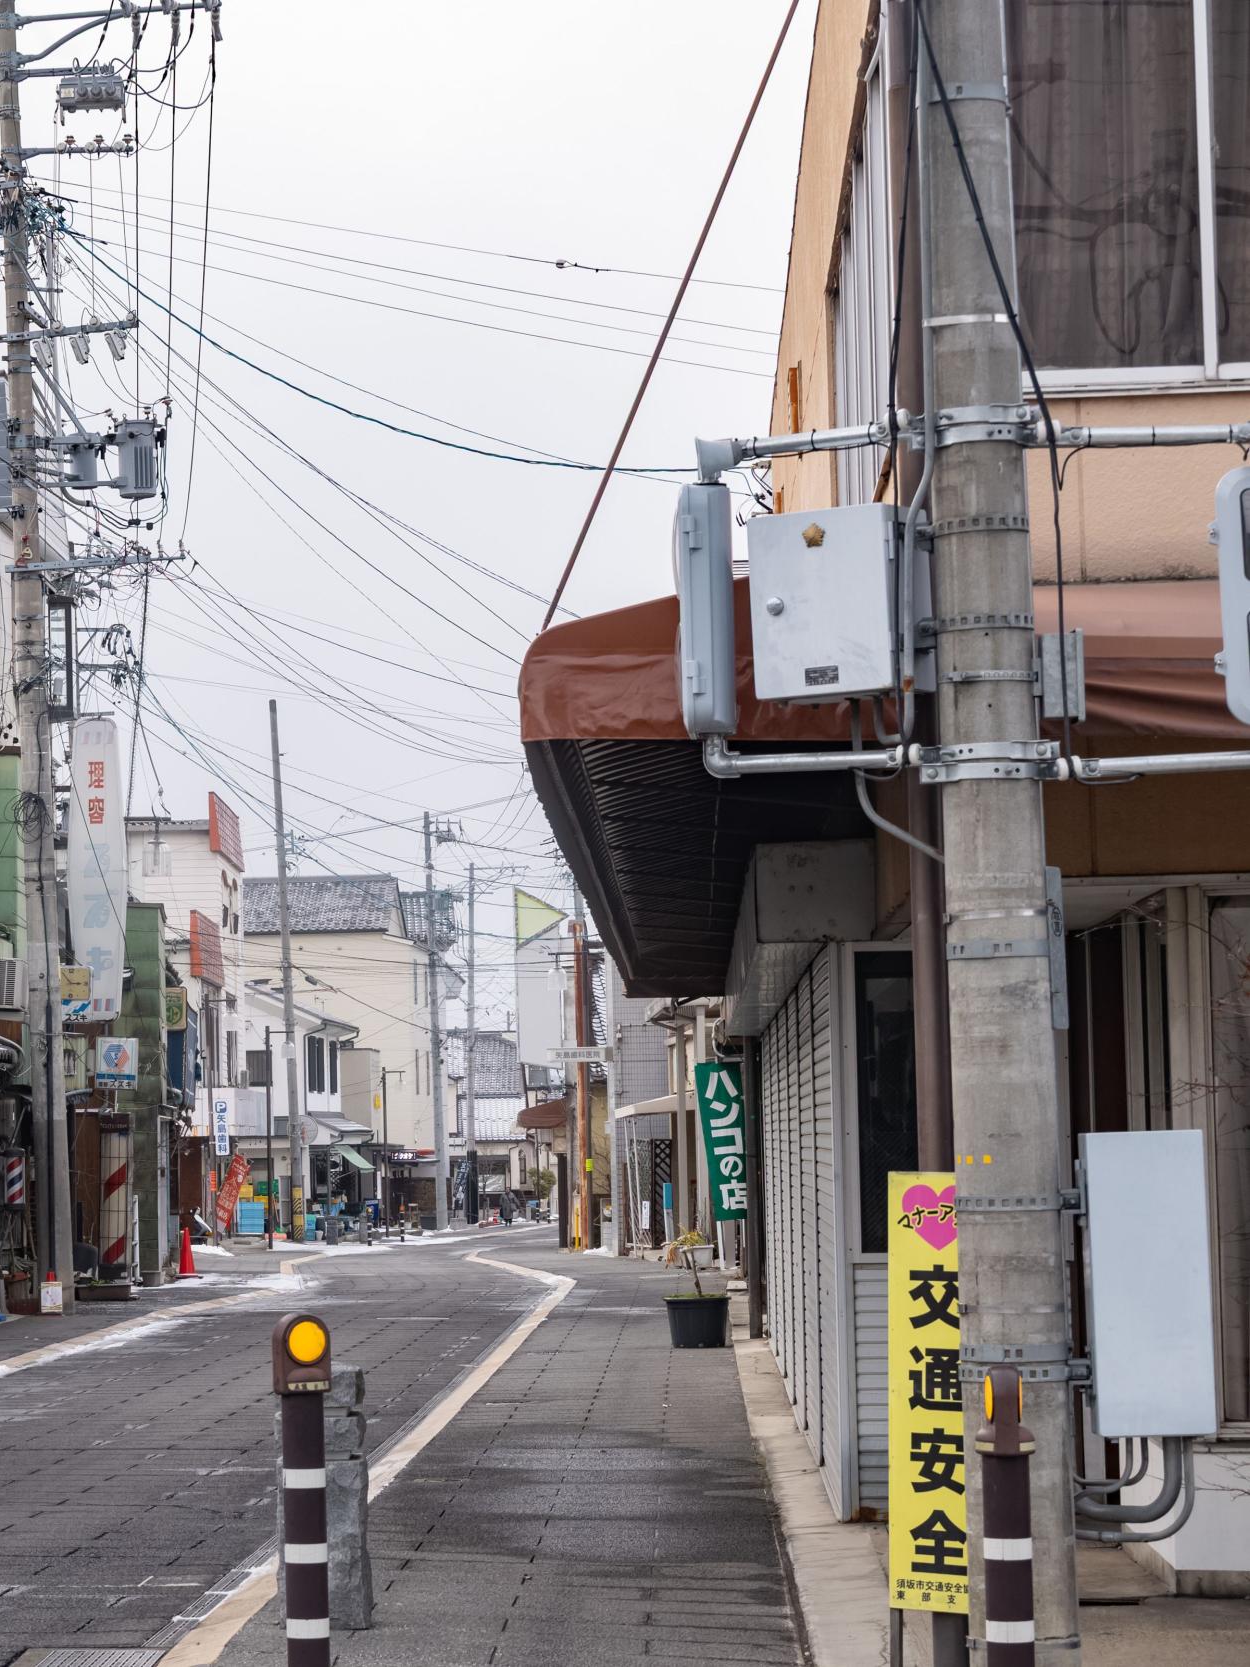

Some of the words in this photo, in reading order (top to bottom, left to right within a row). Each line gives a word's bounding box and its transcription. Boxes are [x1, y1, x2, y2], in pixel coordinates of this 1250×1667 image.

[88, 761, 105, 825] 理容
[65, 1013, 88, 1022] スズキ
[216, 1114, 228, 1154] 矢島歯科
[704, 1069, 748, 1211] ハンコの店
[908, 1263, 968, 1576] 交通安全
